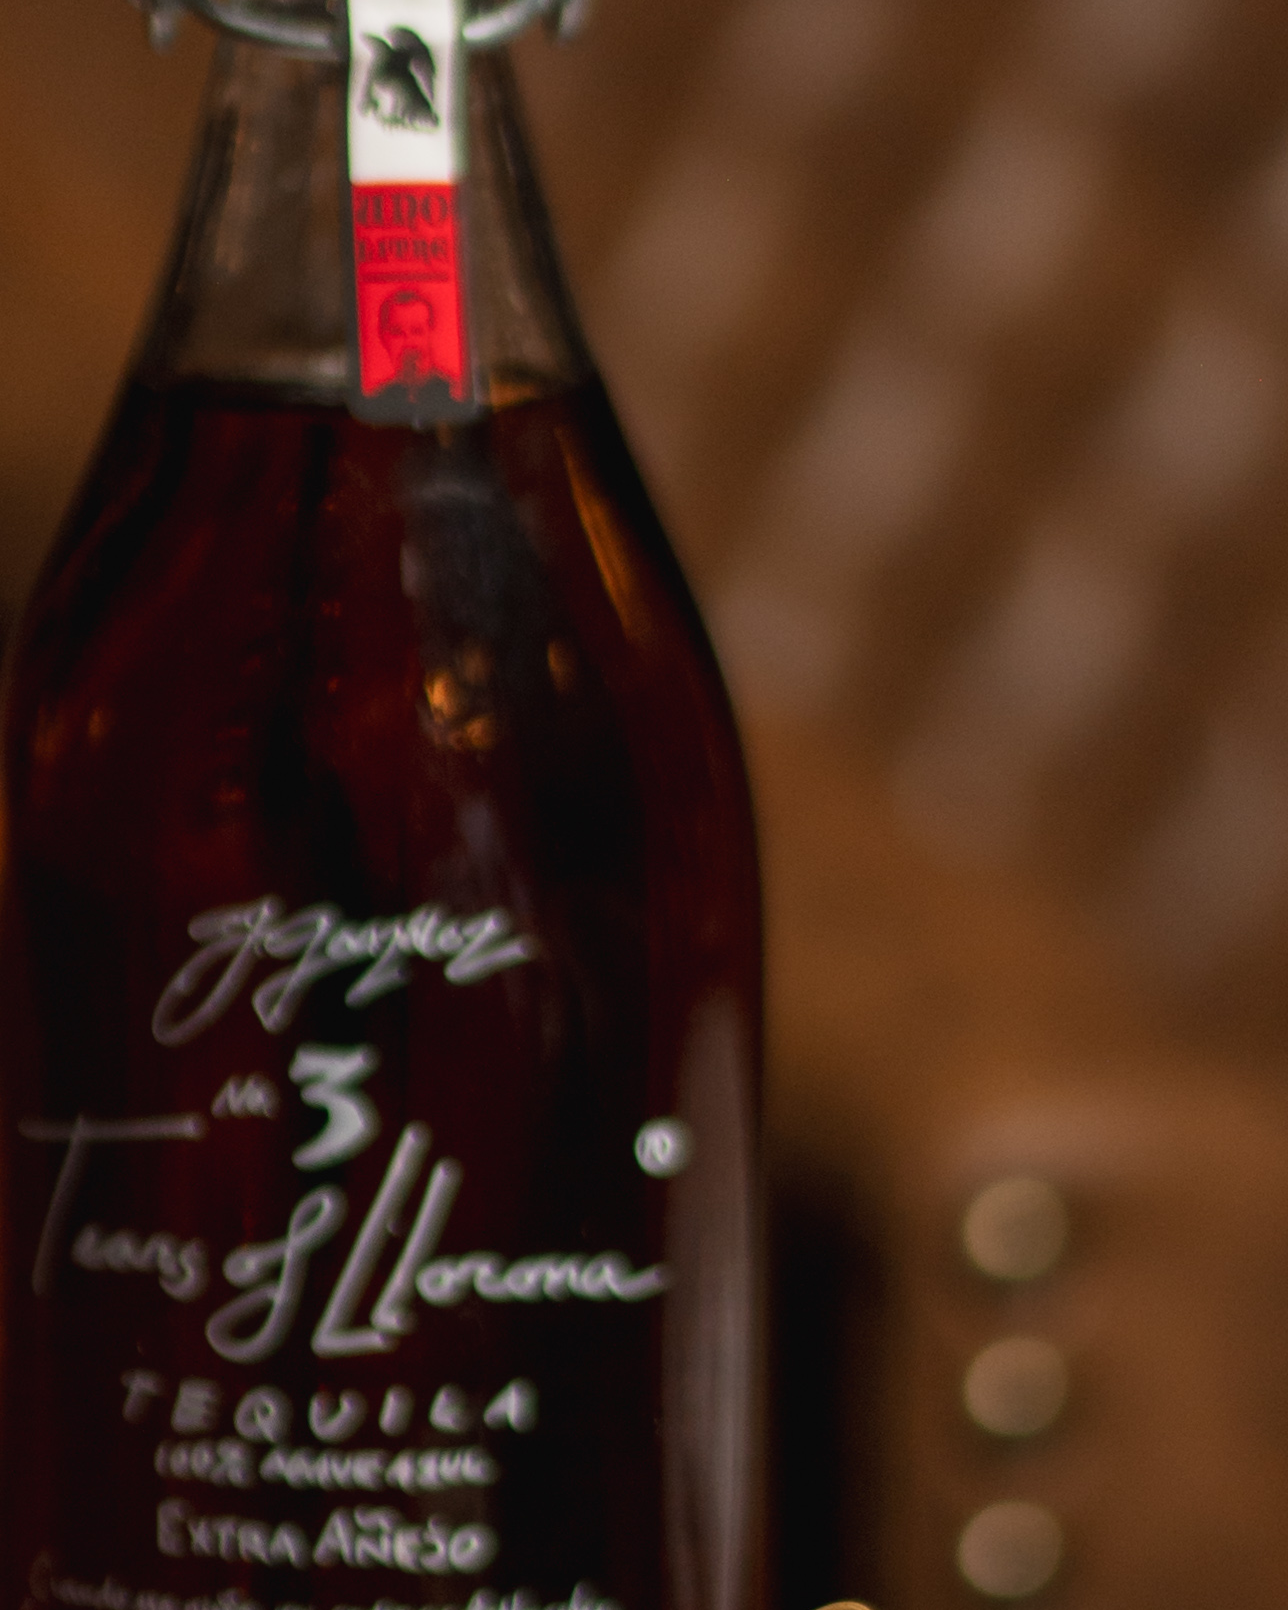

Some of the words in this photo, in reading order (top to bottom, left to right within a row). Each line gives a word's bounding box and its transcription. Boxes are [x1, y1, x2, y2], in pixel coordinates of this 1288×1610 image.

[288, 1044, 381, 1169] 3
[205, 1183, 348, 1363] of
[313, 1121, 669, 1357] Llorona
[121, 1368, 539, 1443] TEQUILA
